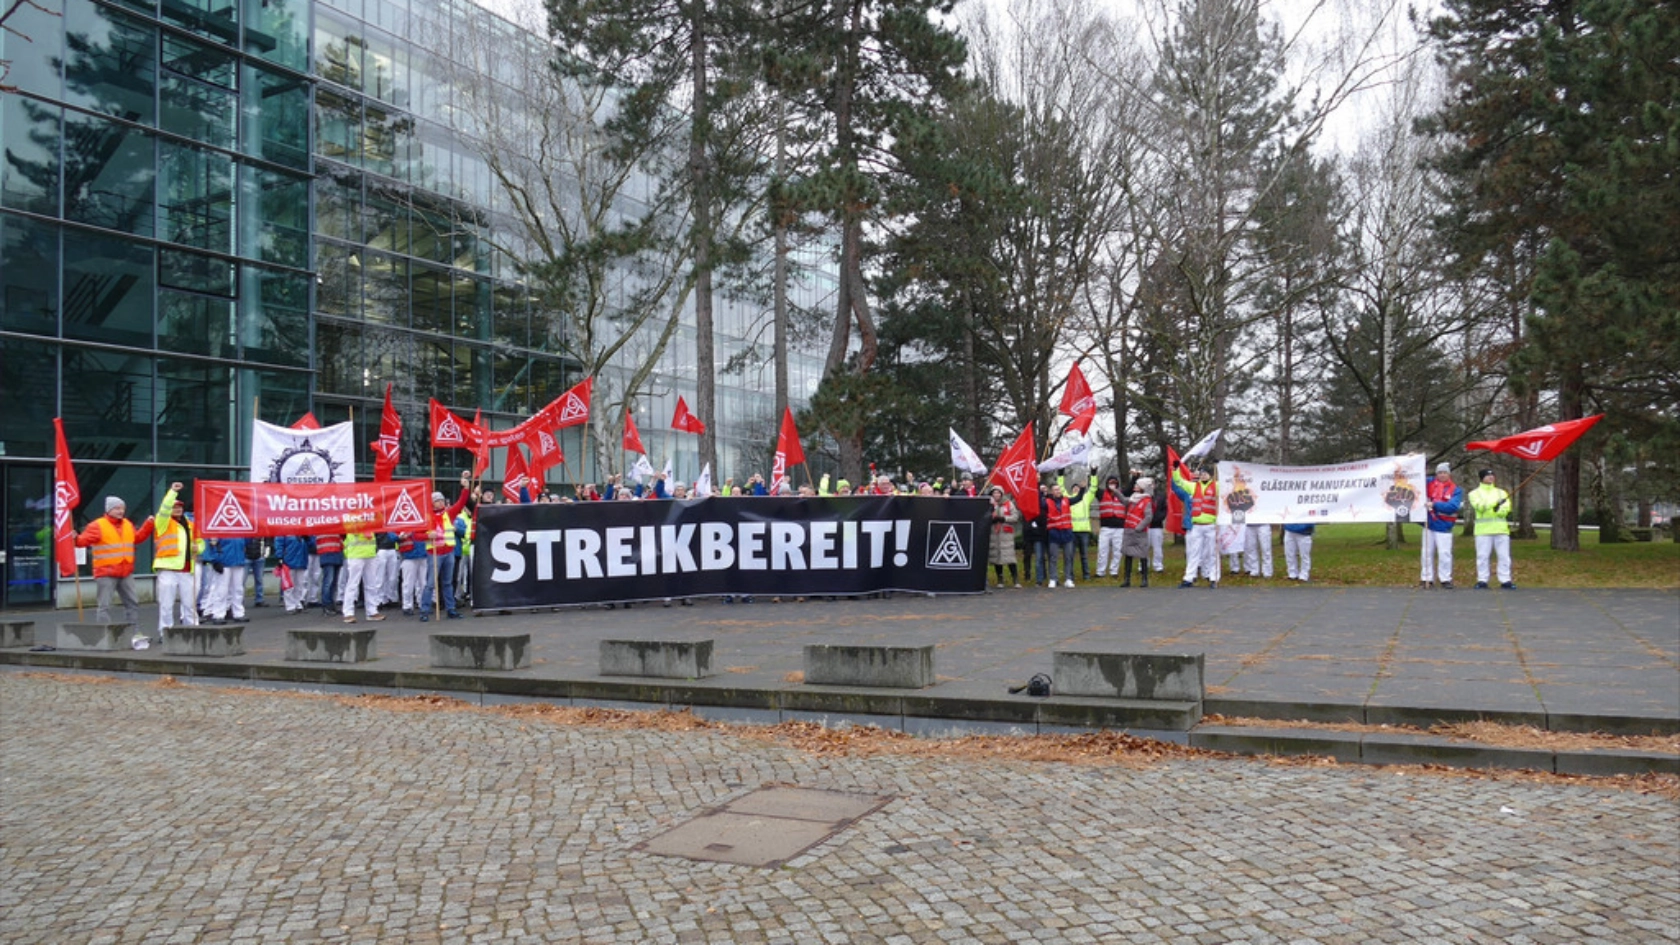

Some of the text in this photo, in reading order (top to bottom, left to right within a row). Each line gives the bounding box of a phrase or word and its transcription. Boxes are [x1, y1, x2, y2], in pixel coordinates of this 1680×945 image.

[1260, 478, 1307, 491] GLÄSERNE
[1310, 477, 1377, 490] MANUFAKTUR
[266, 493, 375, 511] Warnstreik
[1297, 494, 1339, 505] DRESDEN
[267, 511, 376, 527] unser gutes Recht
[490, 519, 912, 583] STREIKBEREIT!
